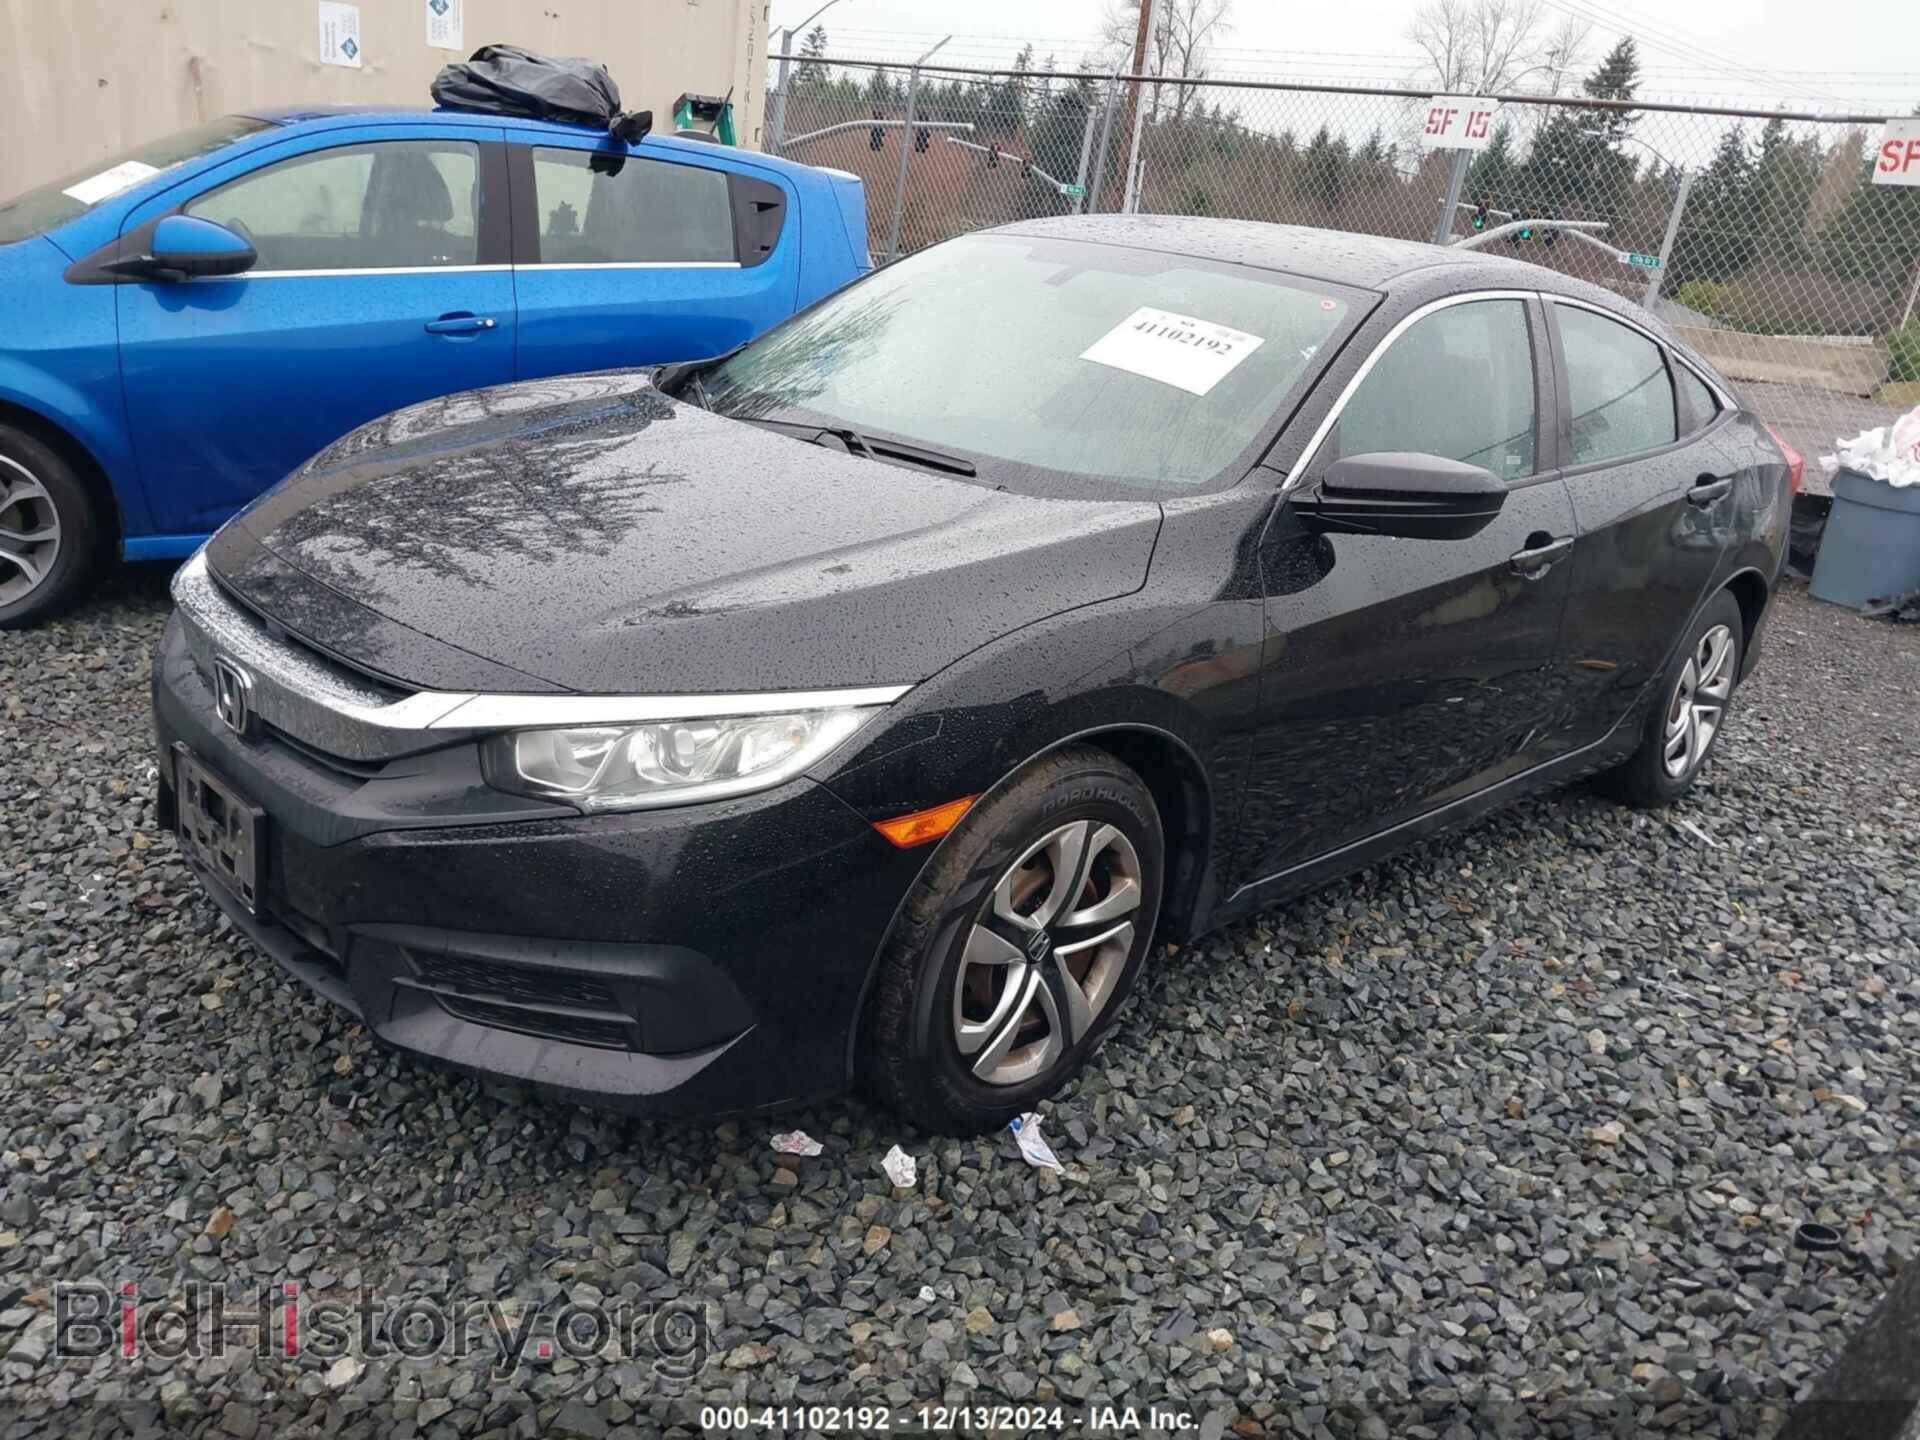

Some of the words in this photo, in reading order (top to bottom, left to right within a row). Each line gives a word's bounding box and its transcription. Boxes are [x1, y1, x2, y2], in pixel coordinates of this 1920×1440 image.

[1425, 108, 1458, 135] SF
[1465, 111, 1491, 138] 15
[1880, 140, 1920, 173] SF
[1133, 320, 1233, 356] 41102192
